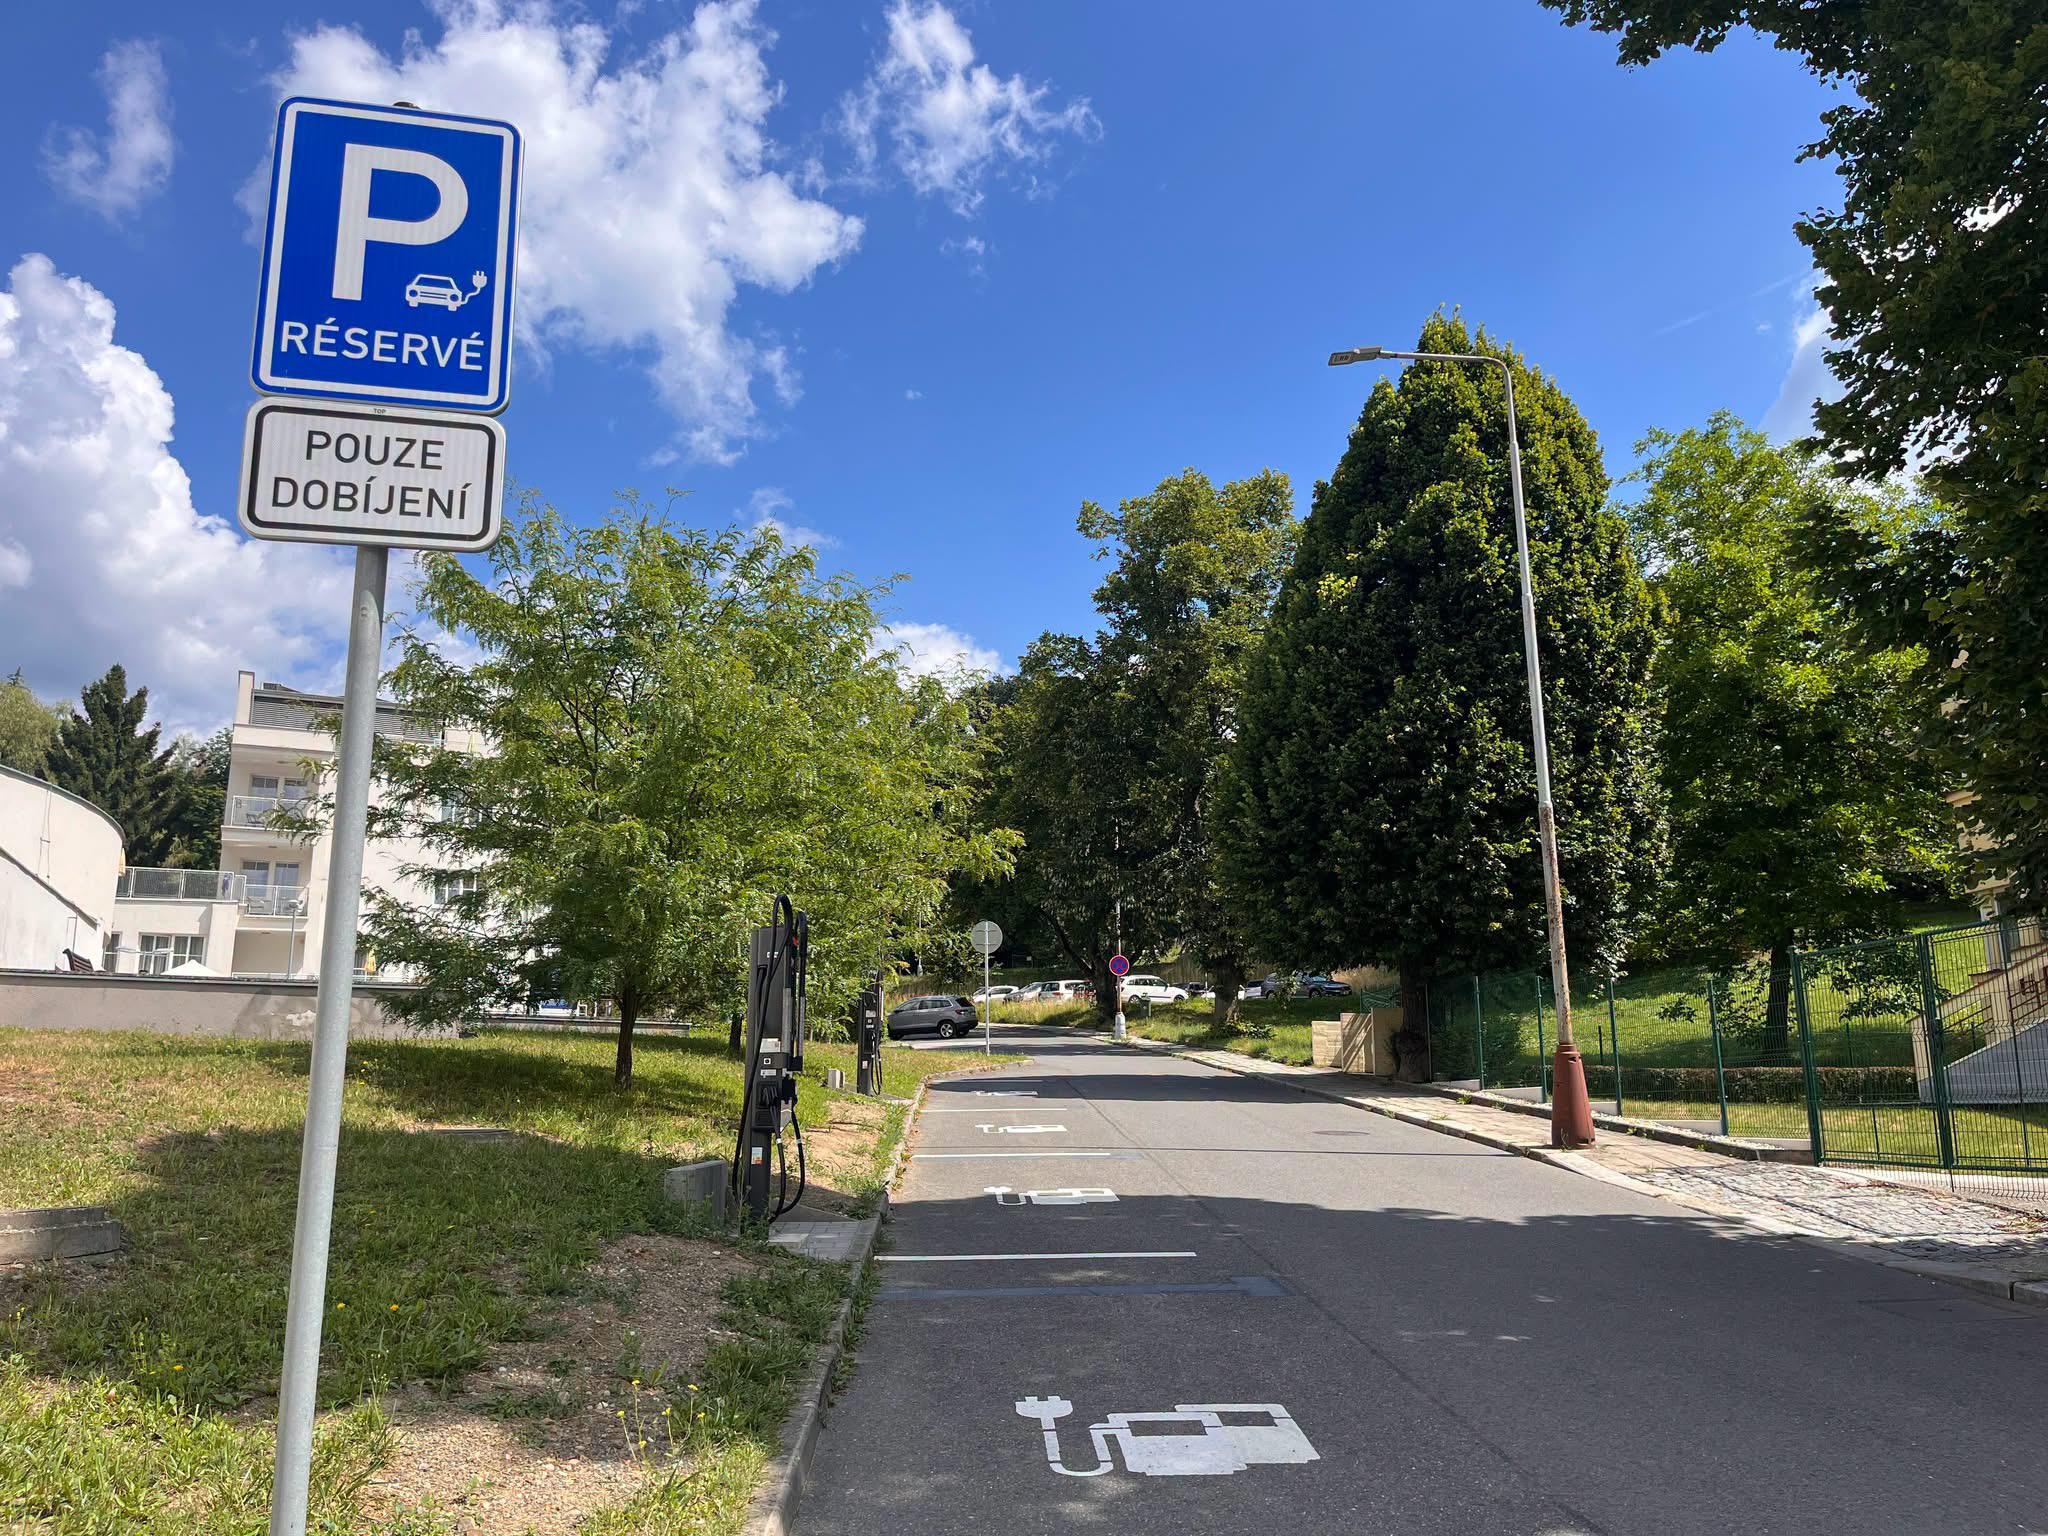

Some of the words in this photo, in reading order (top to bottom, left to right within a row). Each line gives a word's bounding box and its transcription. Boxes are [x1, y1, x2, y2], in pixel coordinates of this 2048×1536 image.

[332, 142, 468, 300] P
[281, 317, 485, 371] RÉSERVÉ
[305, 430, 444, 470] POUZE
[272, 475, 473, 520] DOBÍJENÍ
